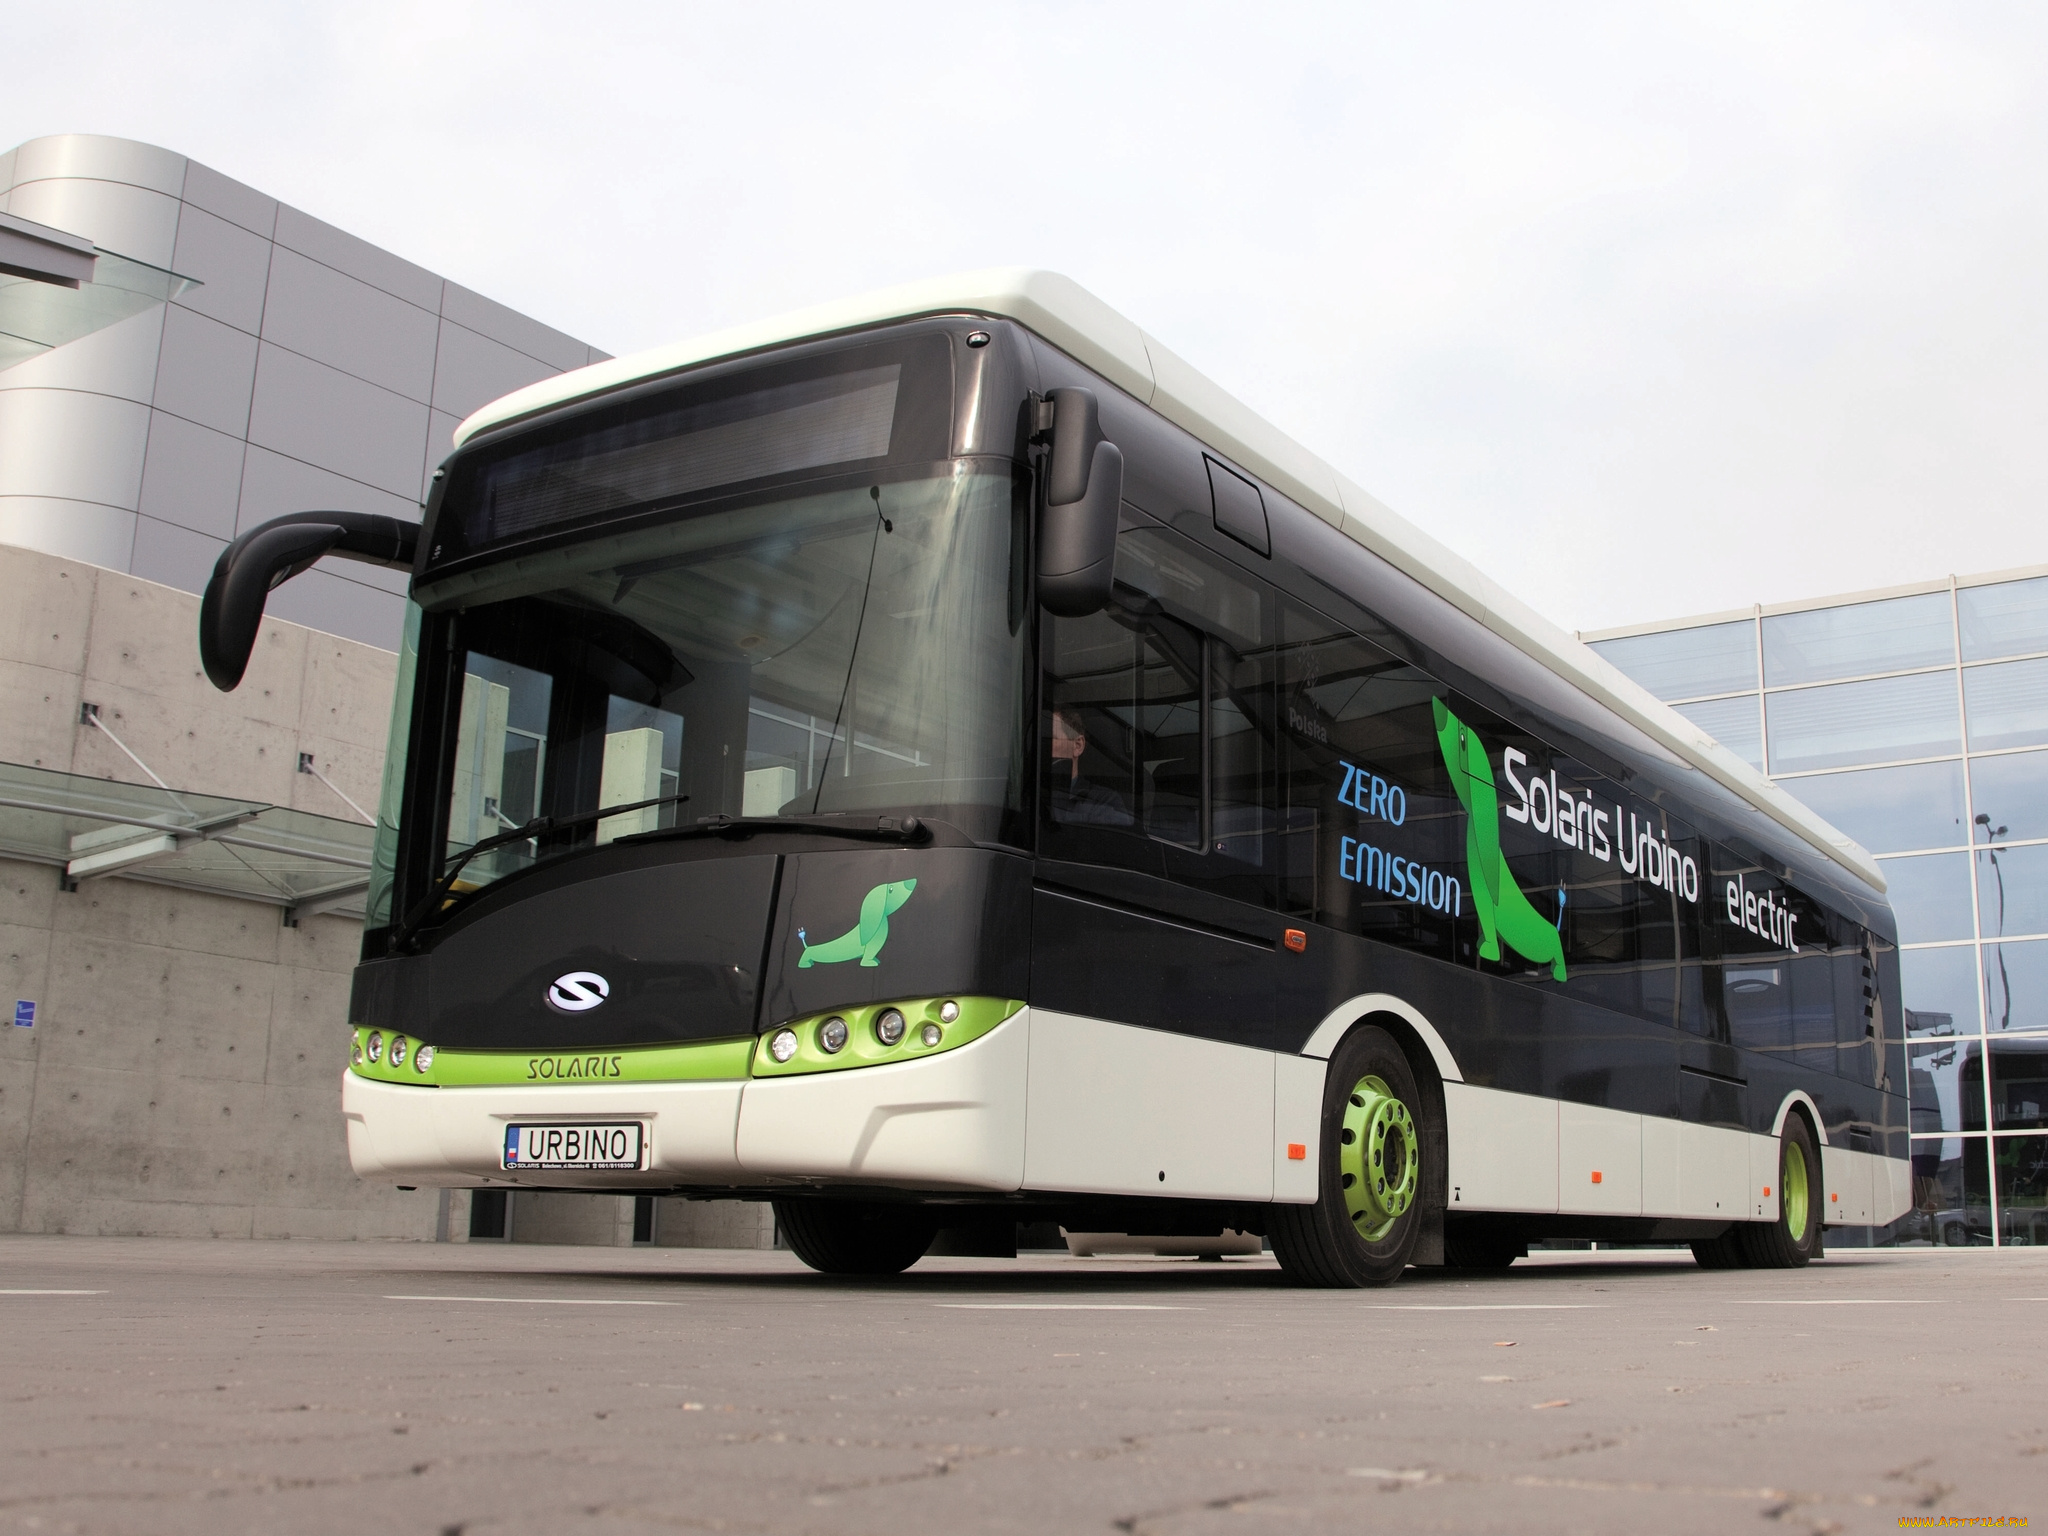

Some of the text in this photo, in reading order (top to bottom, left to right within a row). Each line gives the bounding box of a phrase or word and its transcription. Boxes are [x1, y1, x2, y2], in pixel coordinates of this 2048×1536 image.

[1288, 706, 1328, 744] Polska
[1337, 760, 1406, 826] ZERO
[1504, 746, 1799, 953] Solaris Urbino electric
[527, 1056, 622, 1079] SOLARIS
[529, 1129, 627, 1160] URBINO
